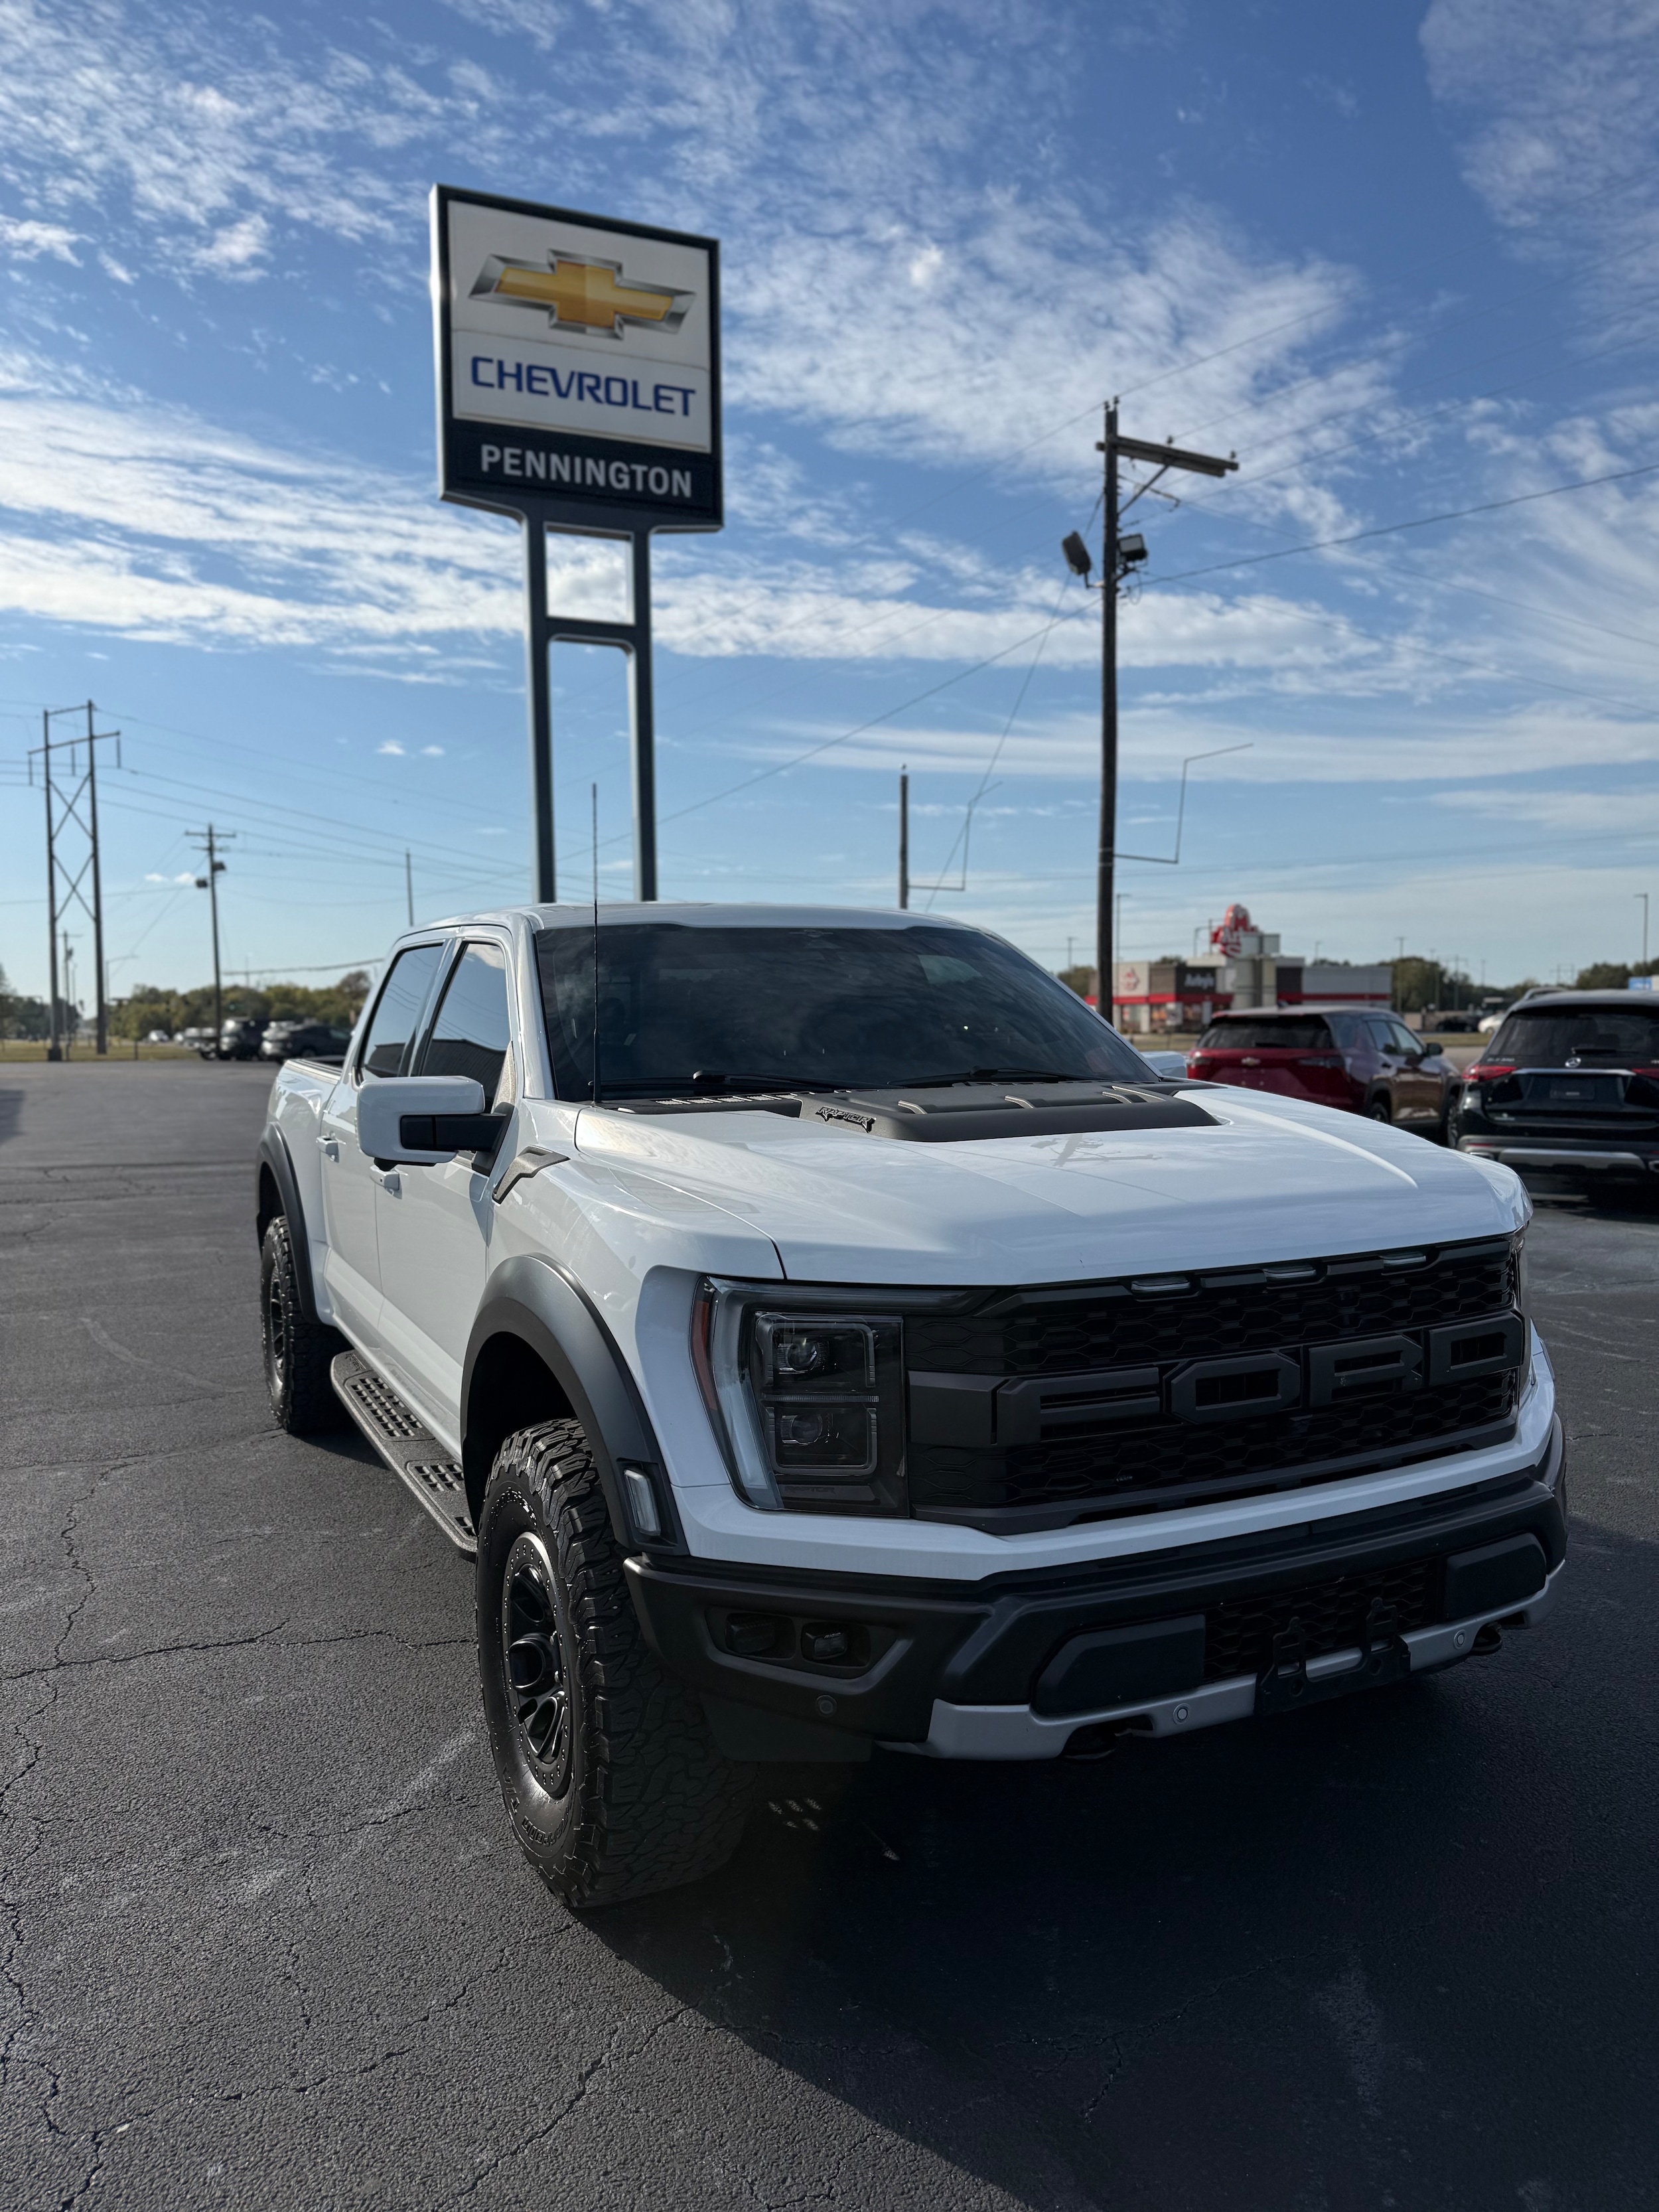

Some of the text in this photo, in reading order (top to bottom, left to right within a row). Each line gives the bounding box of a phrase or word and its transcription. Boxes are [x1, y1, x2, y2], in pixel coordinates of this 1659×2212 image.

[470, 356, 696, 417] CHEVROLET
[481, 444, 691, 498] PENNINGTON
[816, 1106, 877, 1133] RAPTOR
[997, 1311, 1524, 1447] FORD
